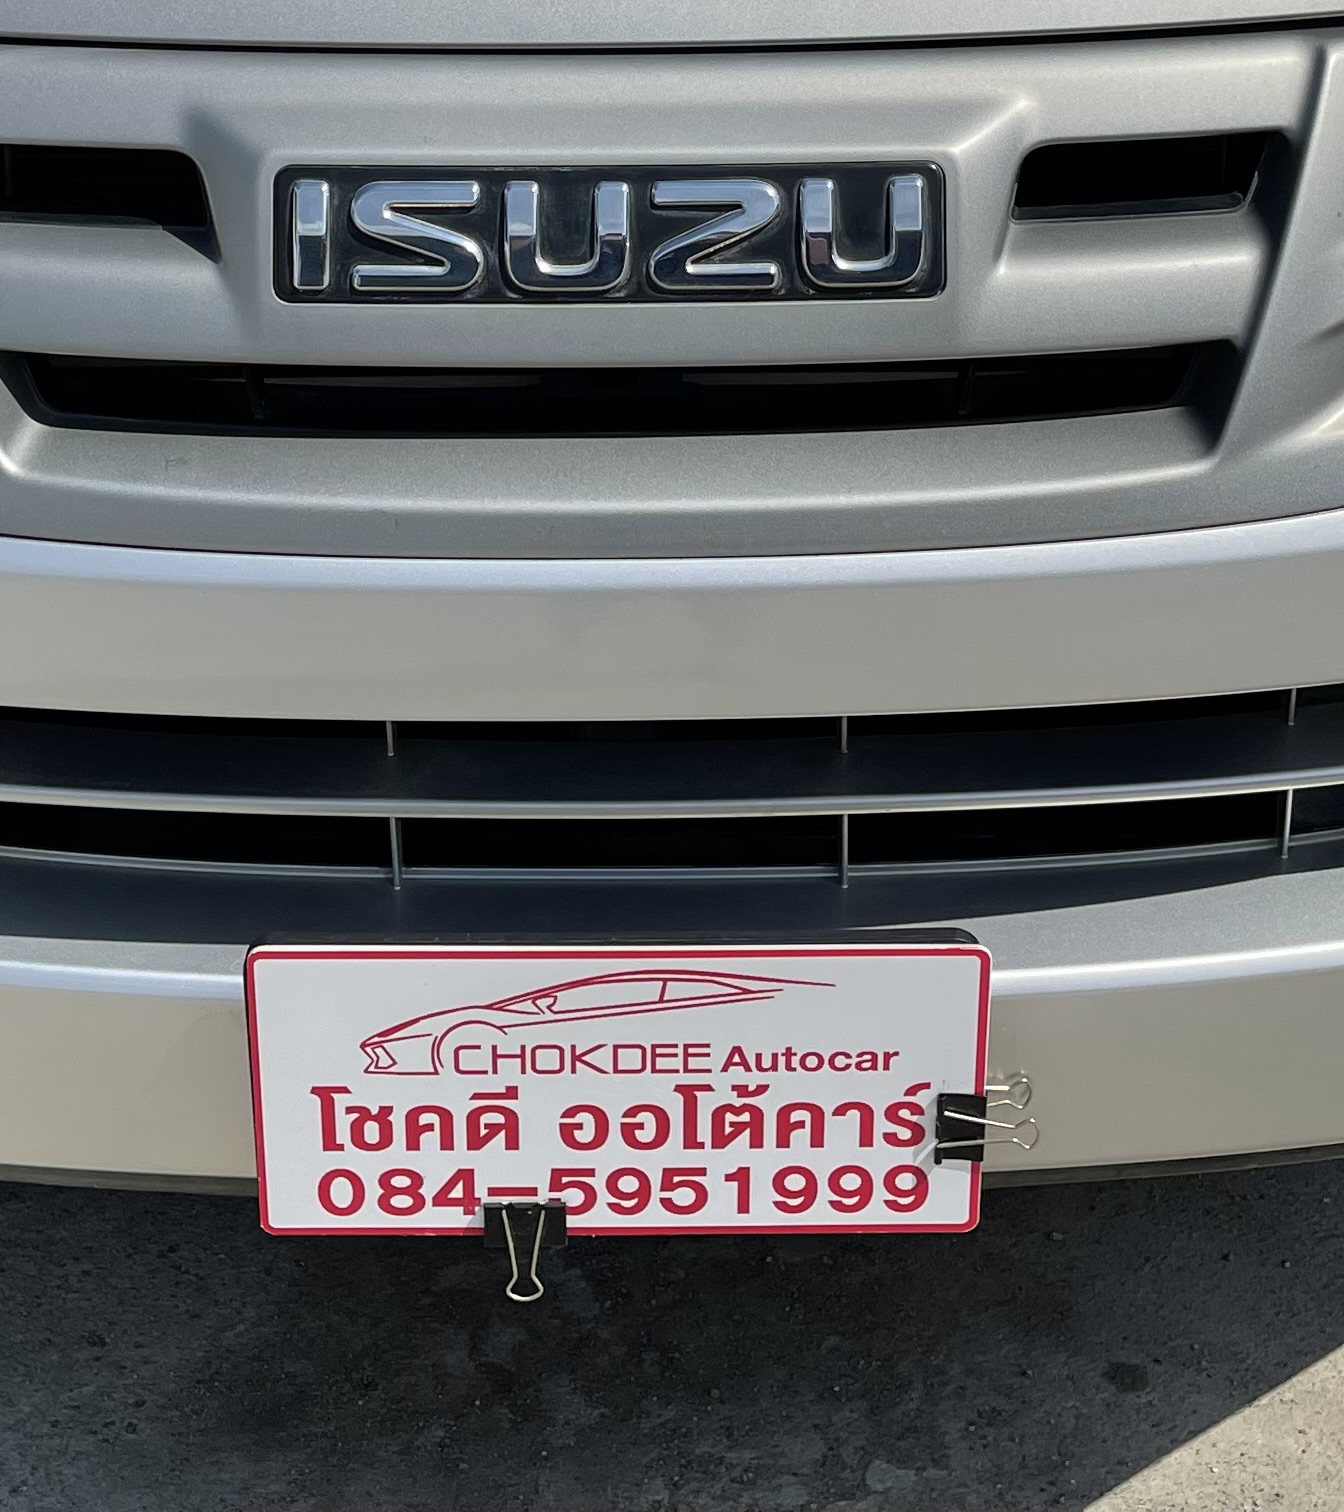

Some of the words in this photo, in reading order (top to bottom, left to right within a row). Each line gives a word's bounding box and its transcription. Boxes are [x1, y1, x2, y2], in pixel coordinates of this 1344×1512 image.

[292, 175, 926, 292] ISUZU
[453, 1042, 713, 1075] CHOKDEE
[719, 1044, 901, 1074] Autocar
[309, 1085, 520, 1152] โชคดี
[558, 1081, 932, 1151] ออโต้คาร์
[317, 1163, 930, 1216] 084-5951999
